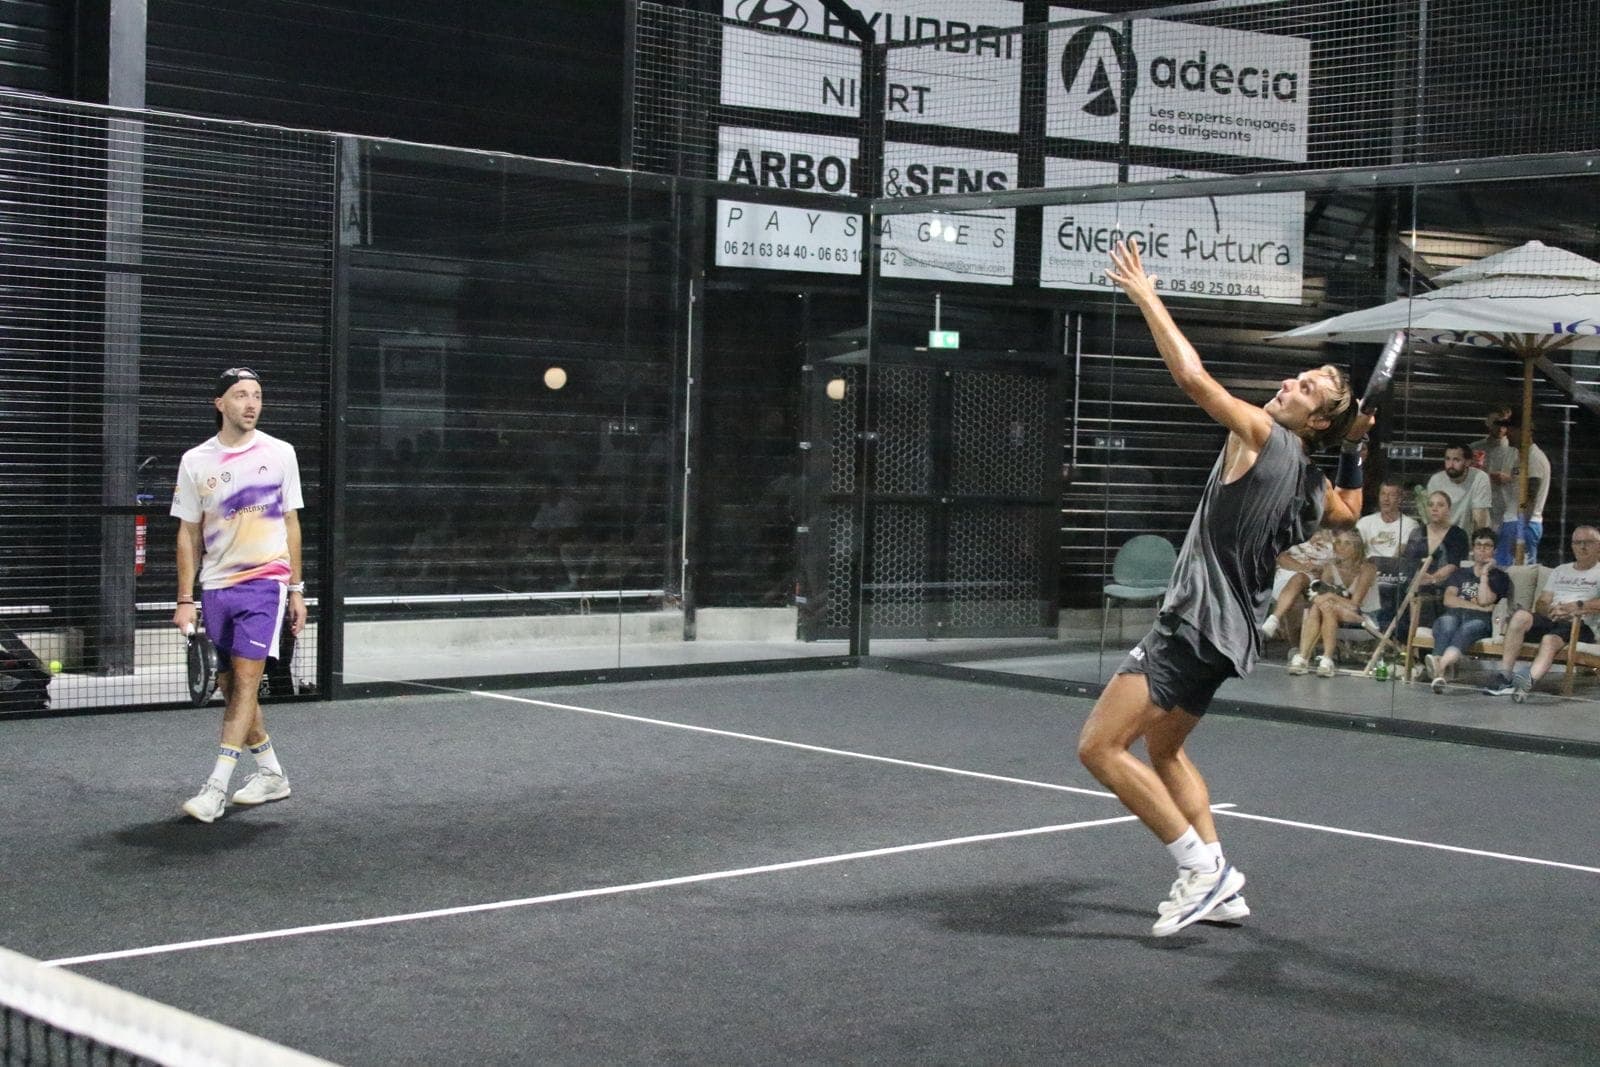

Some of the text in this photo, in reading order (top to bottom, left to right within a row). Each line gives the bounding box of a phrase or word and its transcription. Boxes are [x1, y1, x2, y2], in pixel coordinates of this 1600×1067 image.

[1150, 50, 1298, 103] adecia
[822, 76, 931, 114] NIRT
[1149, 106, 1175, 119] Les
[1178, 110, 1233, 125] experts
[1149, 121, 1252, 142] des dirigeants
[728, 148, 858, 193] ARBO
[724, 240, 738, 255] 06
[742, 241, 755, 256] 21
[759, 242, 773, 257] 63
[776, 243, 790, 258] 84
[793, 245, 807, 259] 40
[818, 247, 831, 261] 06
[835, 248, 848, 262] 63
[883, 251, 897, 266] 42
[1180, 228, 1290, 265] futura
[1170, 279, 1186, 292] 05
[1190, 280, 1205, 293] 49
[1209, 281, 1223, 294] 25
[1227, 282, 1242, 295] 03
[1245, 284, 1260, 296] 44
